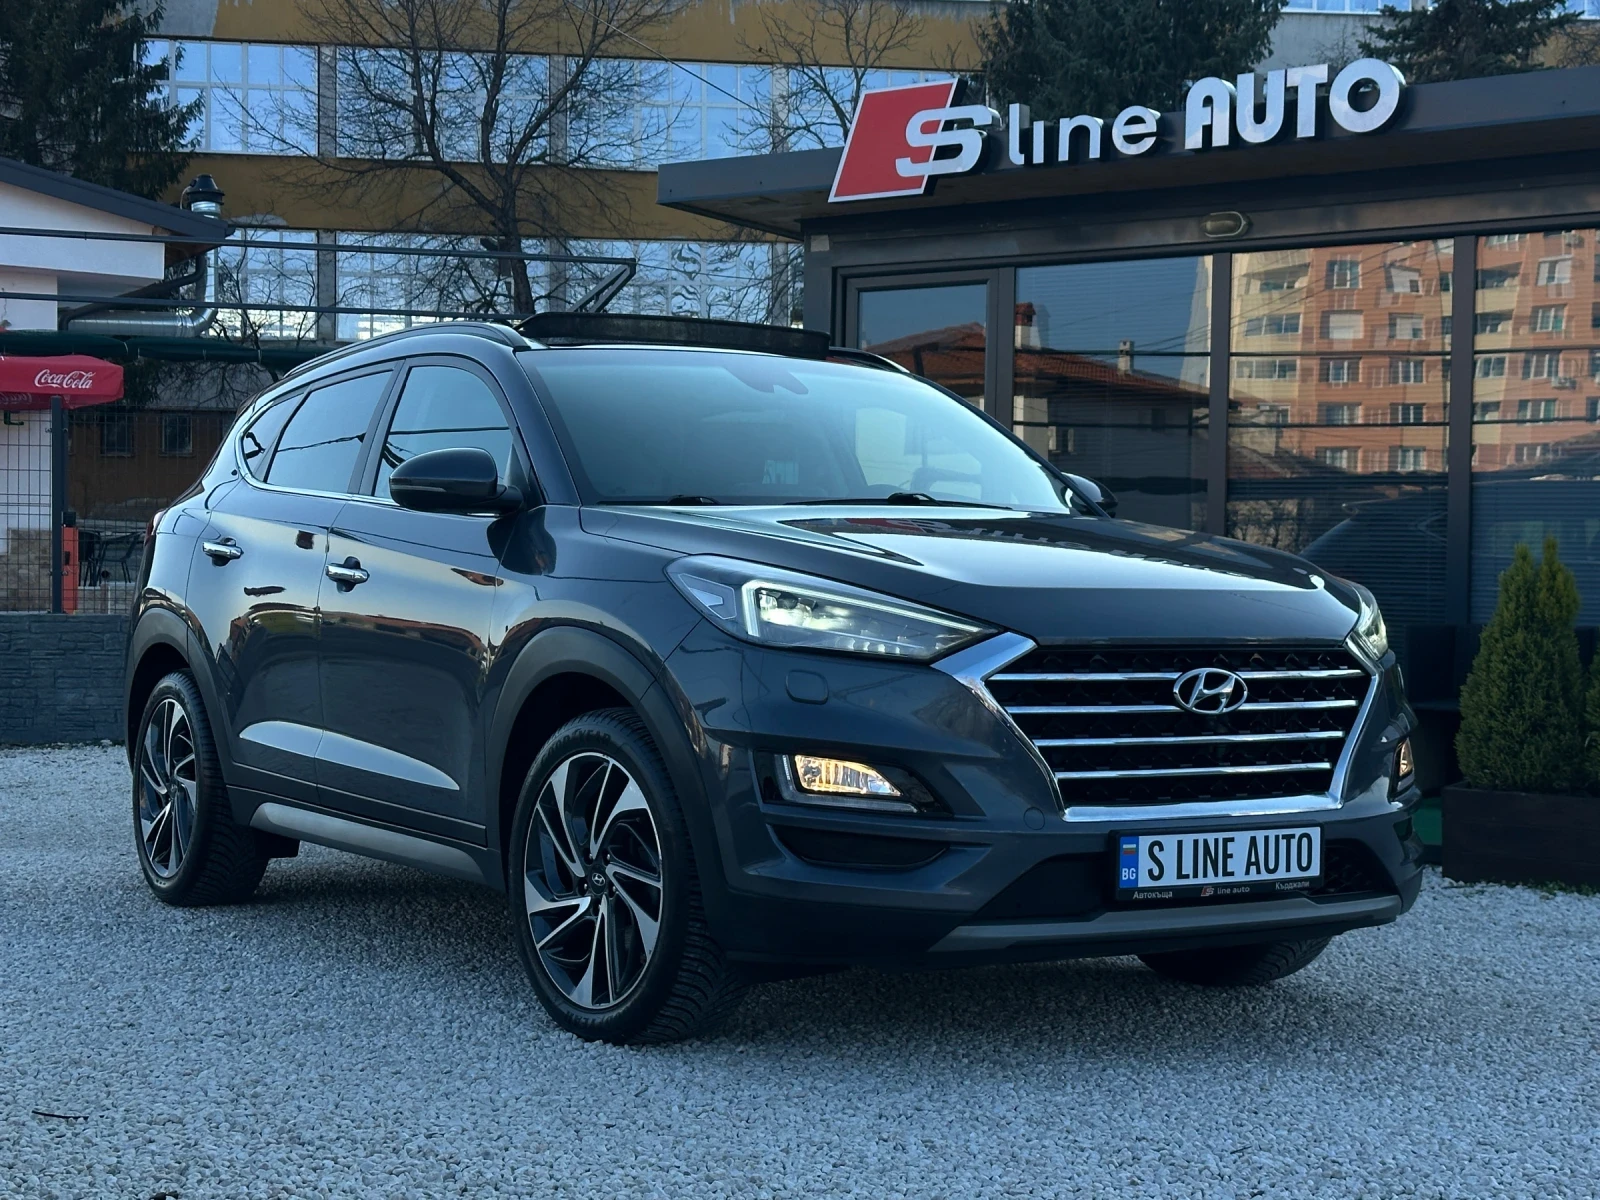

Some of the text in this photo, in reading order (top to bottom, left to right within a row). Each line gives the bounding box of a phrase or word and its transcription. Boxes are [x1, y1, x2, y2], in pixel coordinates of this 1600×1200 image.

[895, 58, 1404, 177] S line AUTO
[35, 369, 96, 388] Coca-Cola
[1147, 832, 1313, 881] S LINE AUTO
[1122, 867, 1136, 881] BG
[1217, 886, 1231, 895] line
[1232, 886, 1250, 894] auto
